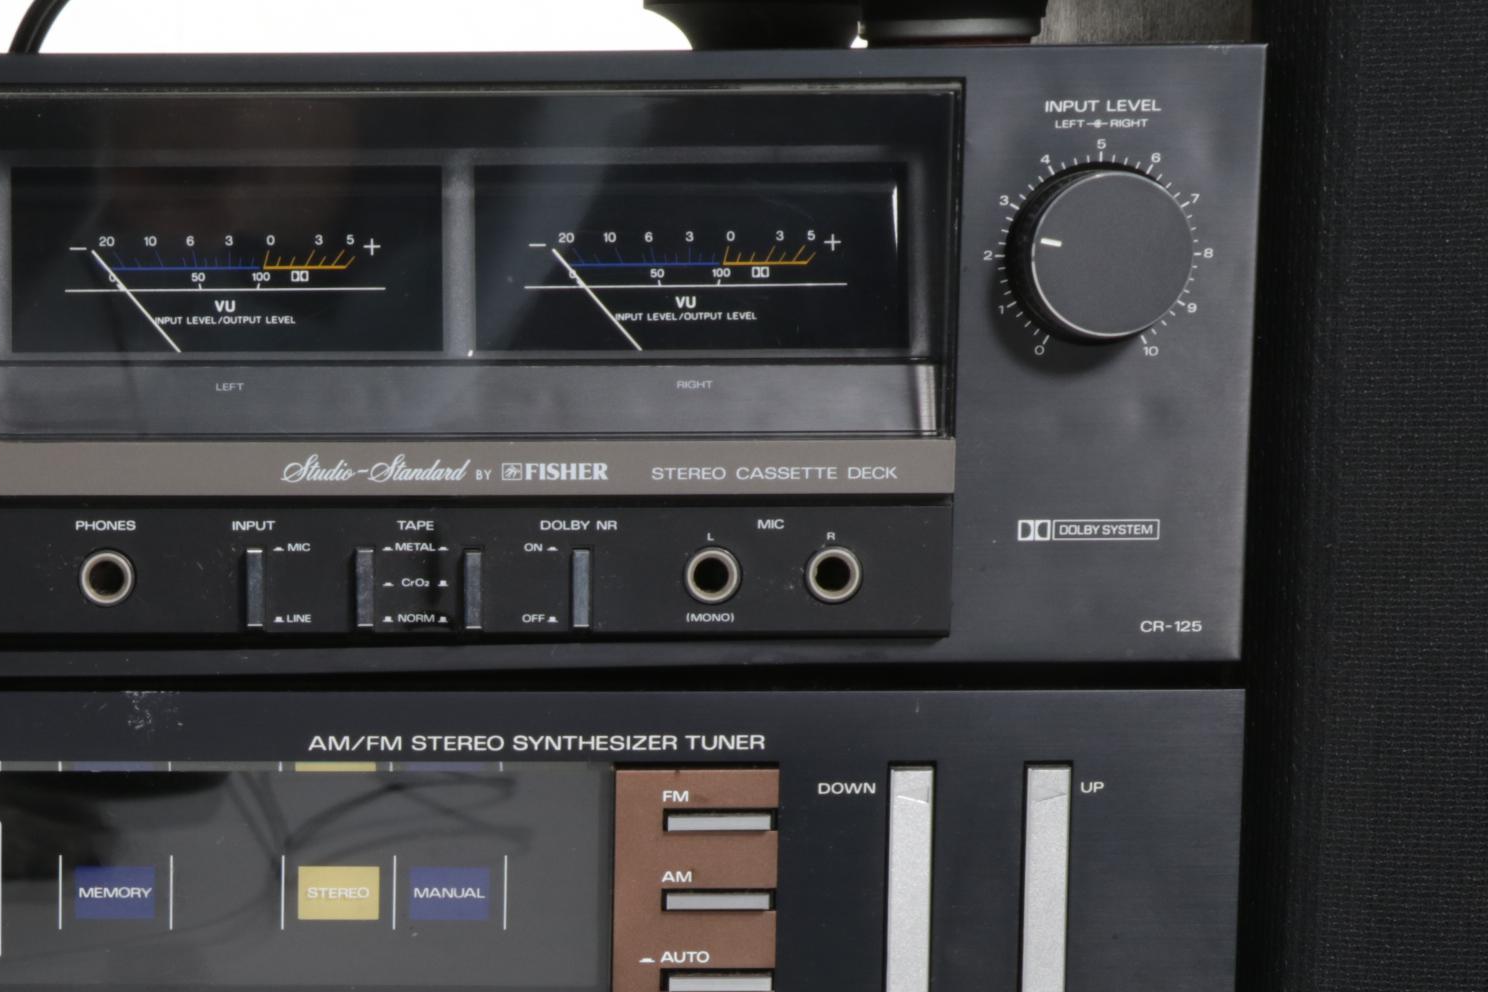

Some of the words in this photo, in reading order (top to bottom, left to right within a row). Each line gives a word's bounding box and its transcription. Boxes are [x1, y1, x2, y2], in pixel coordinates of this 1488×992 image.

[1045, 100, 1099, 112] INPUT
[1107, 99, 1161, 112] LEVEL
[1055, 120, 1085, 128] LEFT
[1110, 119, 1148, 128] RIGHT
[215, 300, 235, 312] VU
[676, 296, 696, 308] VU
[266, 316, 295, 324] LEVEL
[727, 312, 757, 320] LEVEL
[216, 383, 244, 391] LEFT
[677, 380, 712, 389] RIGHT
[476, 469, 491, 480] BY
[526, 463, 608, 480] FISHER
[652, 467, 726, 480] STEREO
[736, 467, 837, 480] CASSETTE
[848, 467, 897, 479] DECK
[76, 520, 136, 531] PHONES
[232, 521, 275, 531] INPUT
[397, 520, 433, 530] TAPE
[540, 520, 590, 530] DOLBY
[597, 520, 617, 530] NR
[758, 519, 784, 529] MIC
[1059, 525, 1100, 535] DOLBY
[1102, 524, 1153, 535] SYSTEM
[707, 533, 714, 541] L
[827, 532, 835, 540] R
[288, 543, 310, 551] MIC
[395, 543, 435, 551] METAL
[524, 543, 543, 552] ON
[287, 614, 311, 623] LINE
[397, 614, 434, 622] NORM
[522, 614, 544, 623] OFF
[686, 613, 734, 622] (MONO)
[1140, 621, 1202, 632] CR-125
[309, 736, 401, 751] AM/FM
[412, 735, 504, 751] STEREO
[513, 735, 677, 751] SYNTHESIZER
[685, 735, 765, 750] TUNER
[818, 782, 875, 794] DOWN
[1081, 782, 1104, 793] UP
[663, 791, 688, 802] FM
[662, 871, 691, 882] AM
[79, 887, 152, 898] MEMORY
[308, 887, 369, 899] STEREO
[414, 888, 484, 898] MANUAL
[661, 951, 709, 963] AUTO
